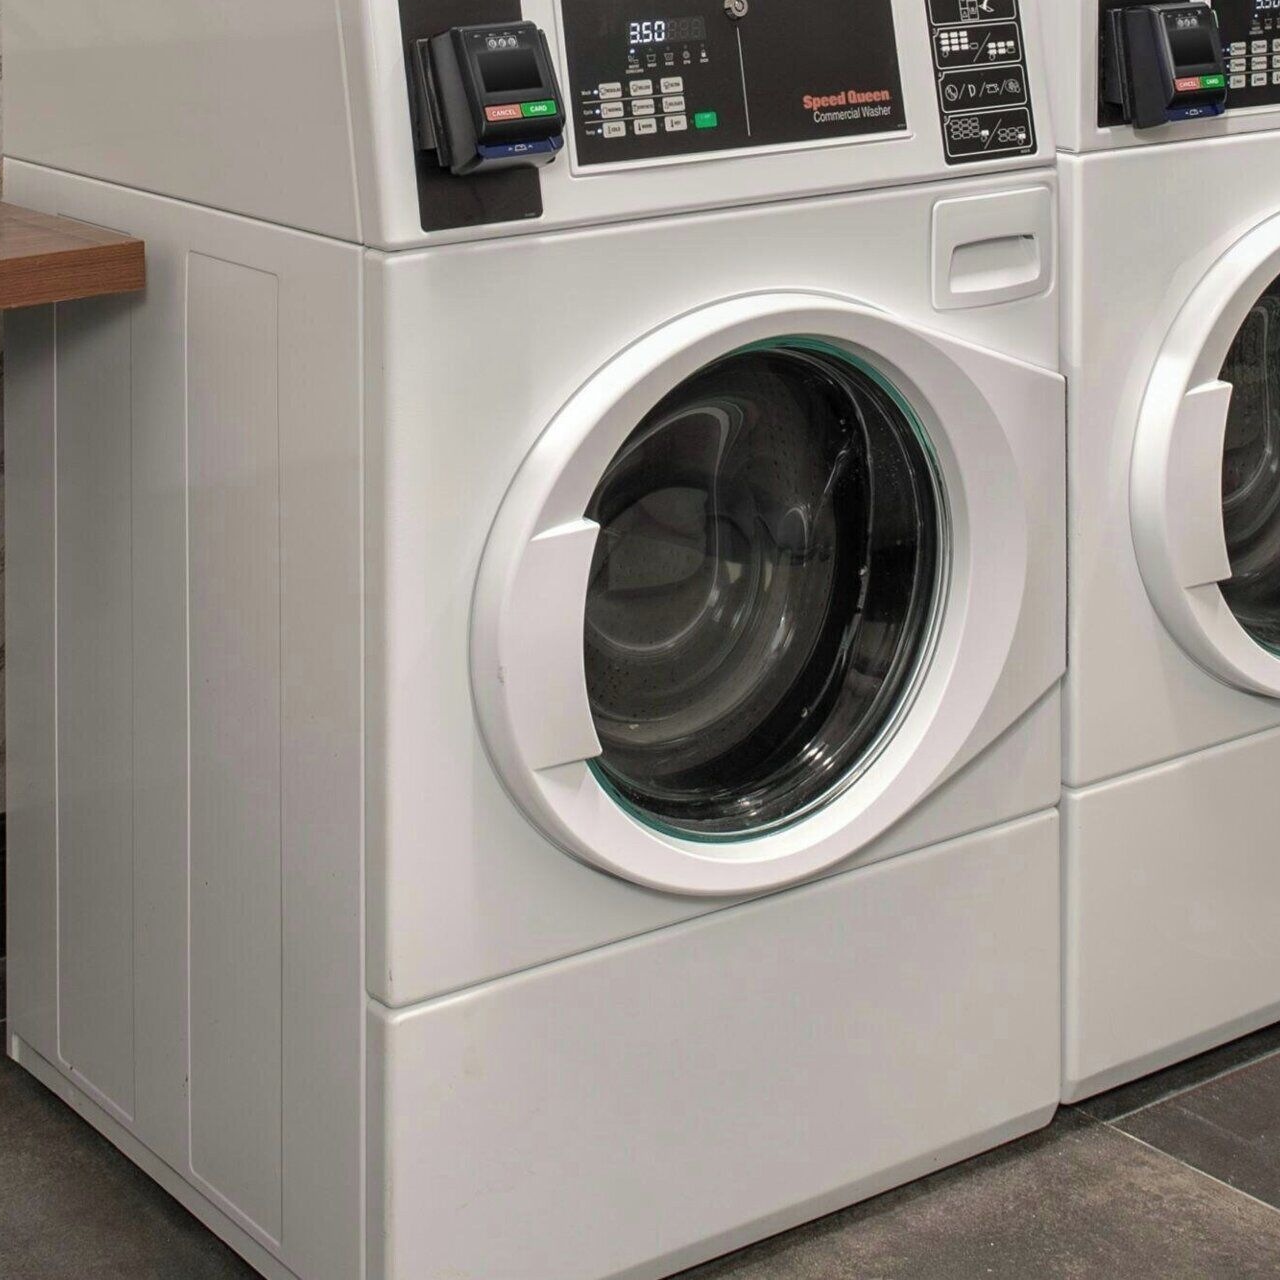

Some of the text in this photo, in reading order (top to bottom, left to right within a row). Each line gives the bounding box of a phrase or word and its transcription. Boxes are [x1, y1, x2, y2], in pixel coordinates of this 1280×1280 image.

[629, 20, 666, 44] 3.50
[803, 89, 890, 111] Speed Queen
[492, 104, 548, 117] CANCEL CARD
[813, 105, 892, 123] Commercial Washer
